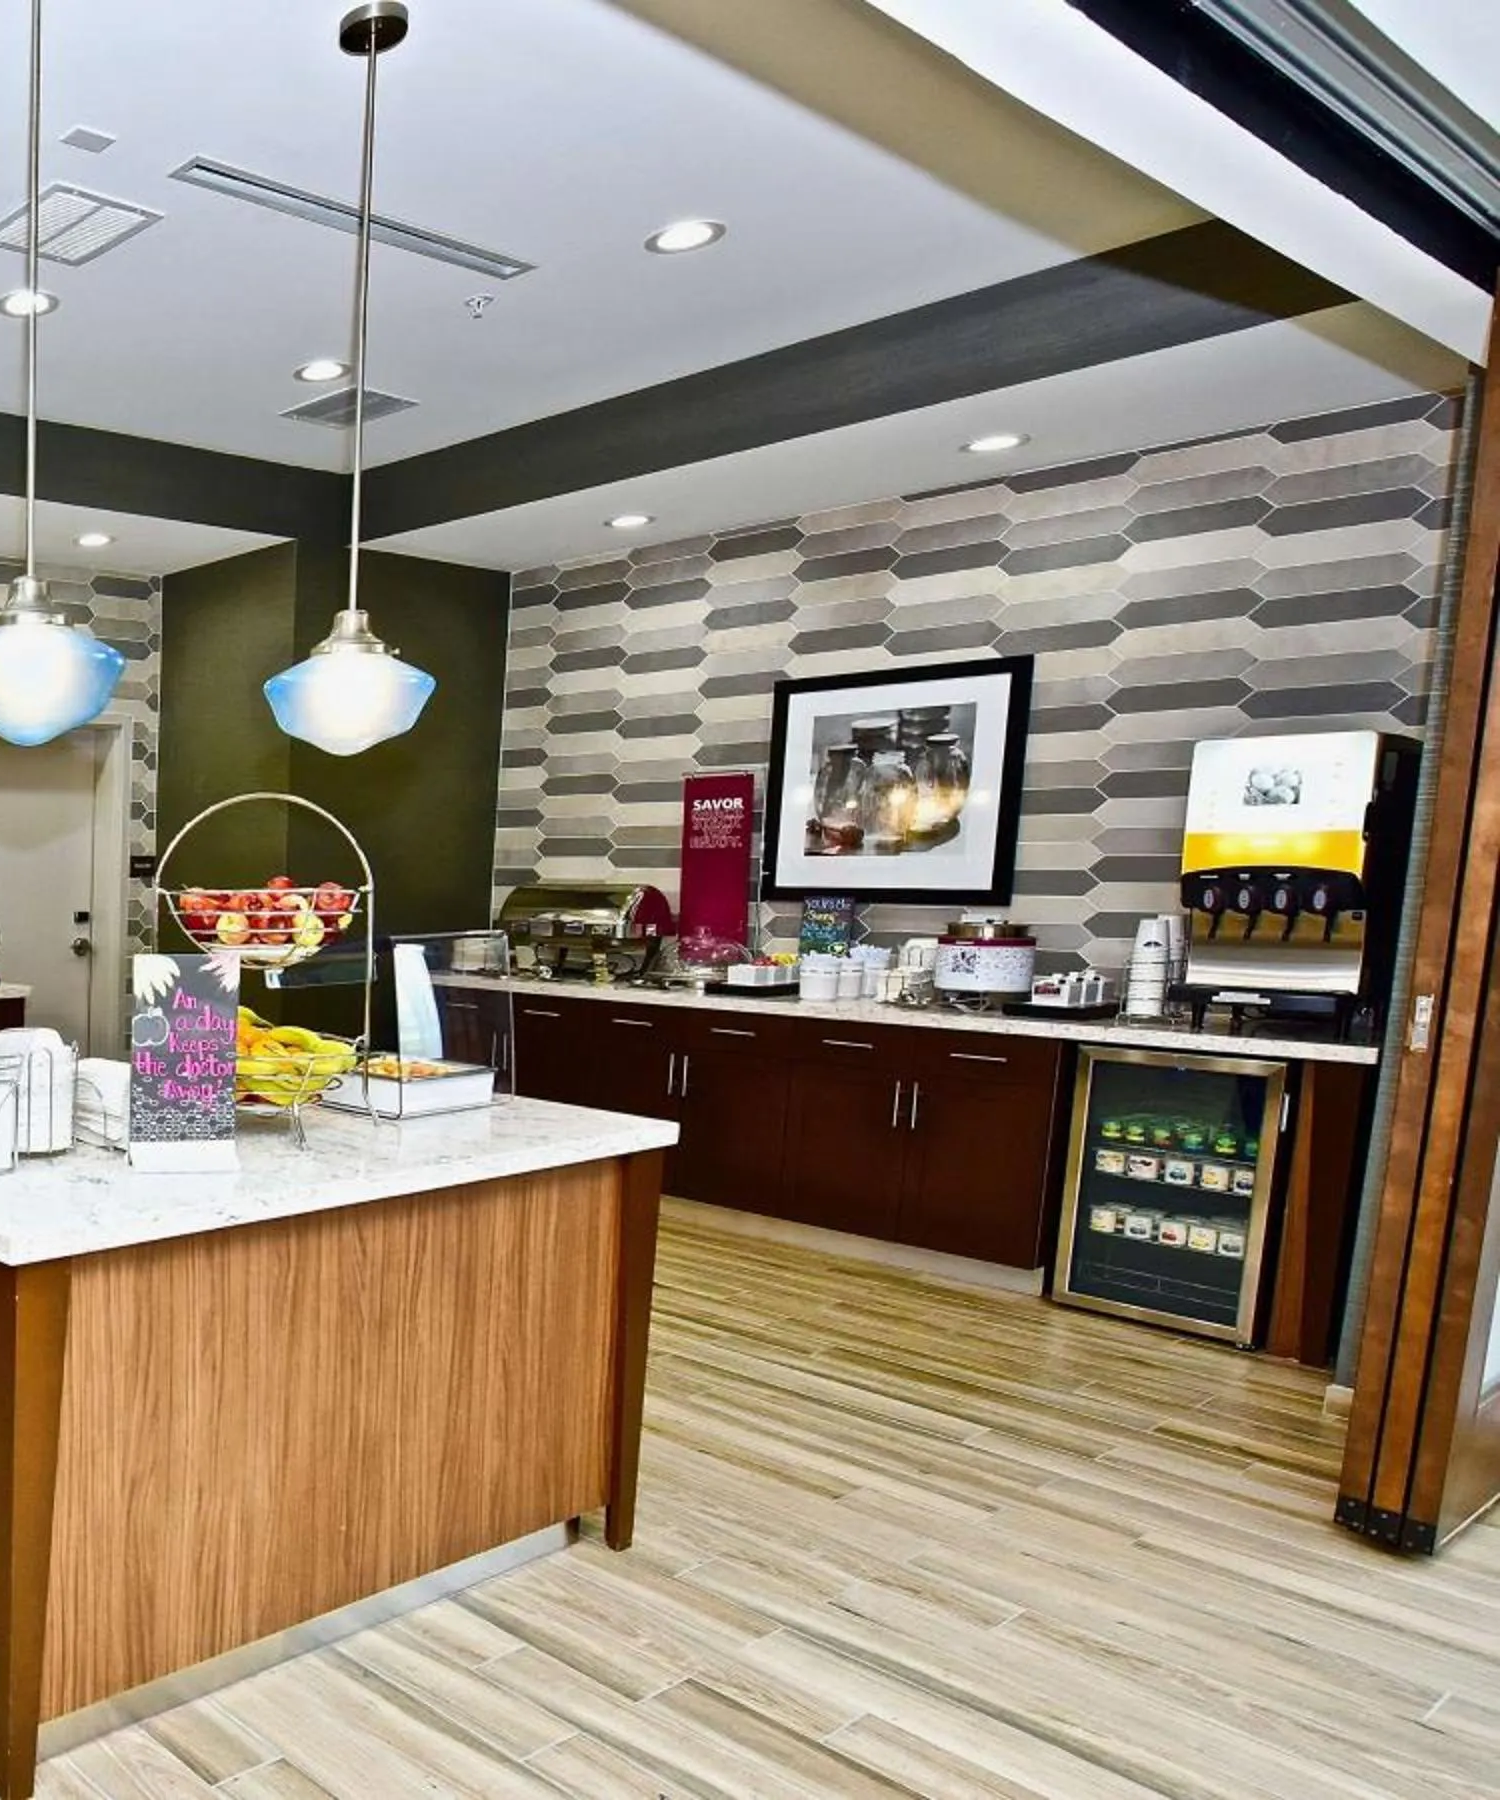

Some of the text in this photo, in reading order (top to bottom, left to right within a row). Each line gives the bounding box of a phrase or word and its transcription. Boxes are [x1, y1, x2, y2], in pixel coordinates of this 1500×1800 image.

[693, 797, 744, 810] SAVOR
[174, 988, 197, 1009] An
[196, 1005, 235, 1044] day
[135, 1052, 235, 1077] the doctor
